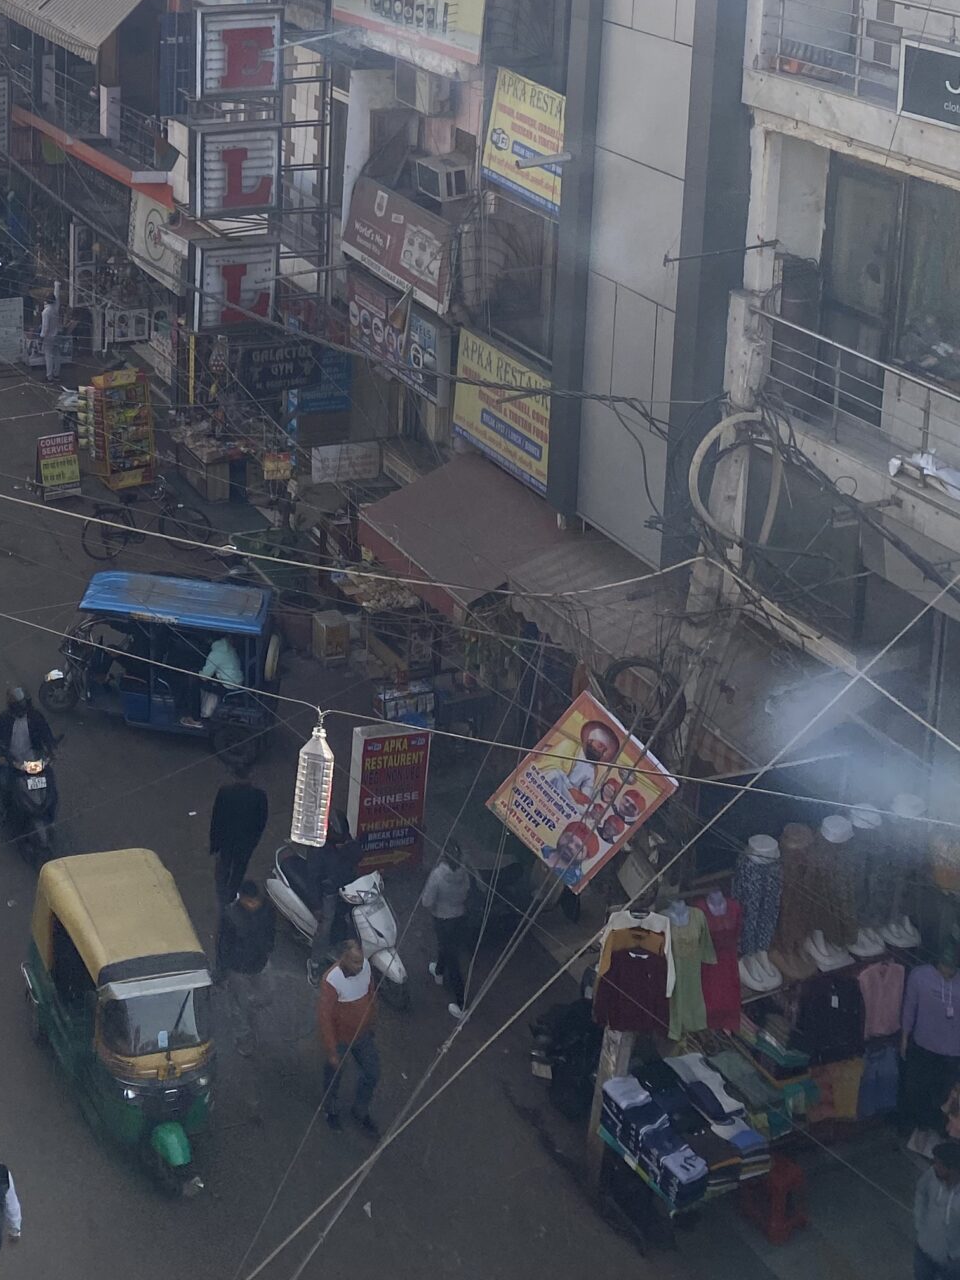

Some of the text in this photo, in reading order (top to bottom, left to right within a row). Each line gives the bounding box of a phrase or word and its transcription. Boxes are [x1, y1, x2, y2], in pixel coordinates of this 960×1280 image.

[499, 73, 526, 103] APKA
[462, 335, 493, 372] APKA
[271, 361, 294, 377] GYM
[40, 434, 74, 447] COURIER
[41, 444, 74, 456] SERVICE
[384, 737, 408, 753] APKA
[364, 751, 424, 771] RESTAURENT
[363, 791, 419, 807] CHINESE
[368, 828, 410, 841] BREAK FAST
